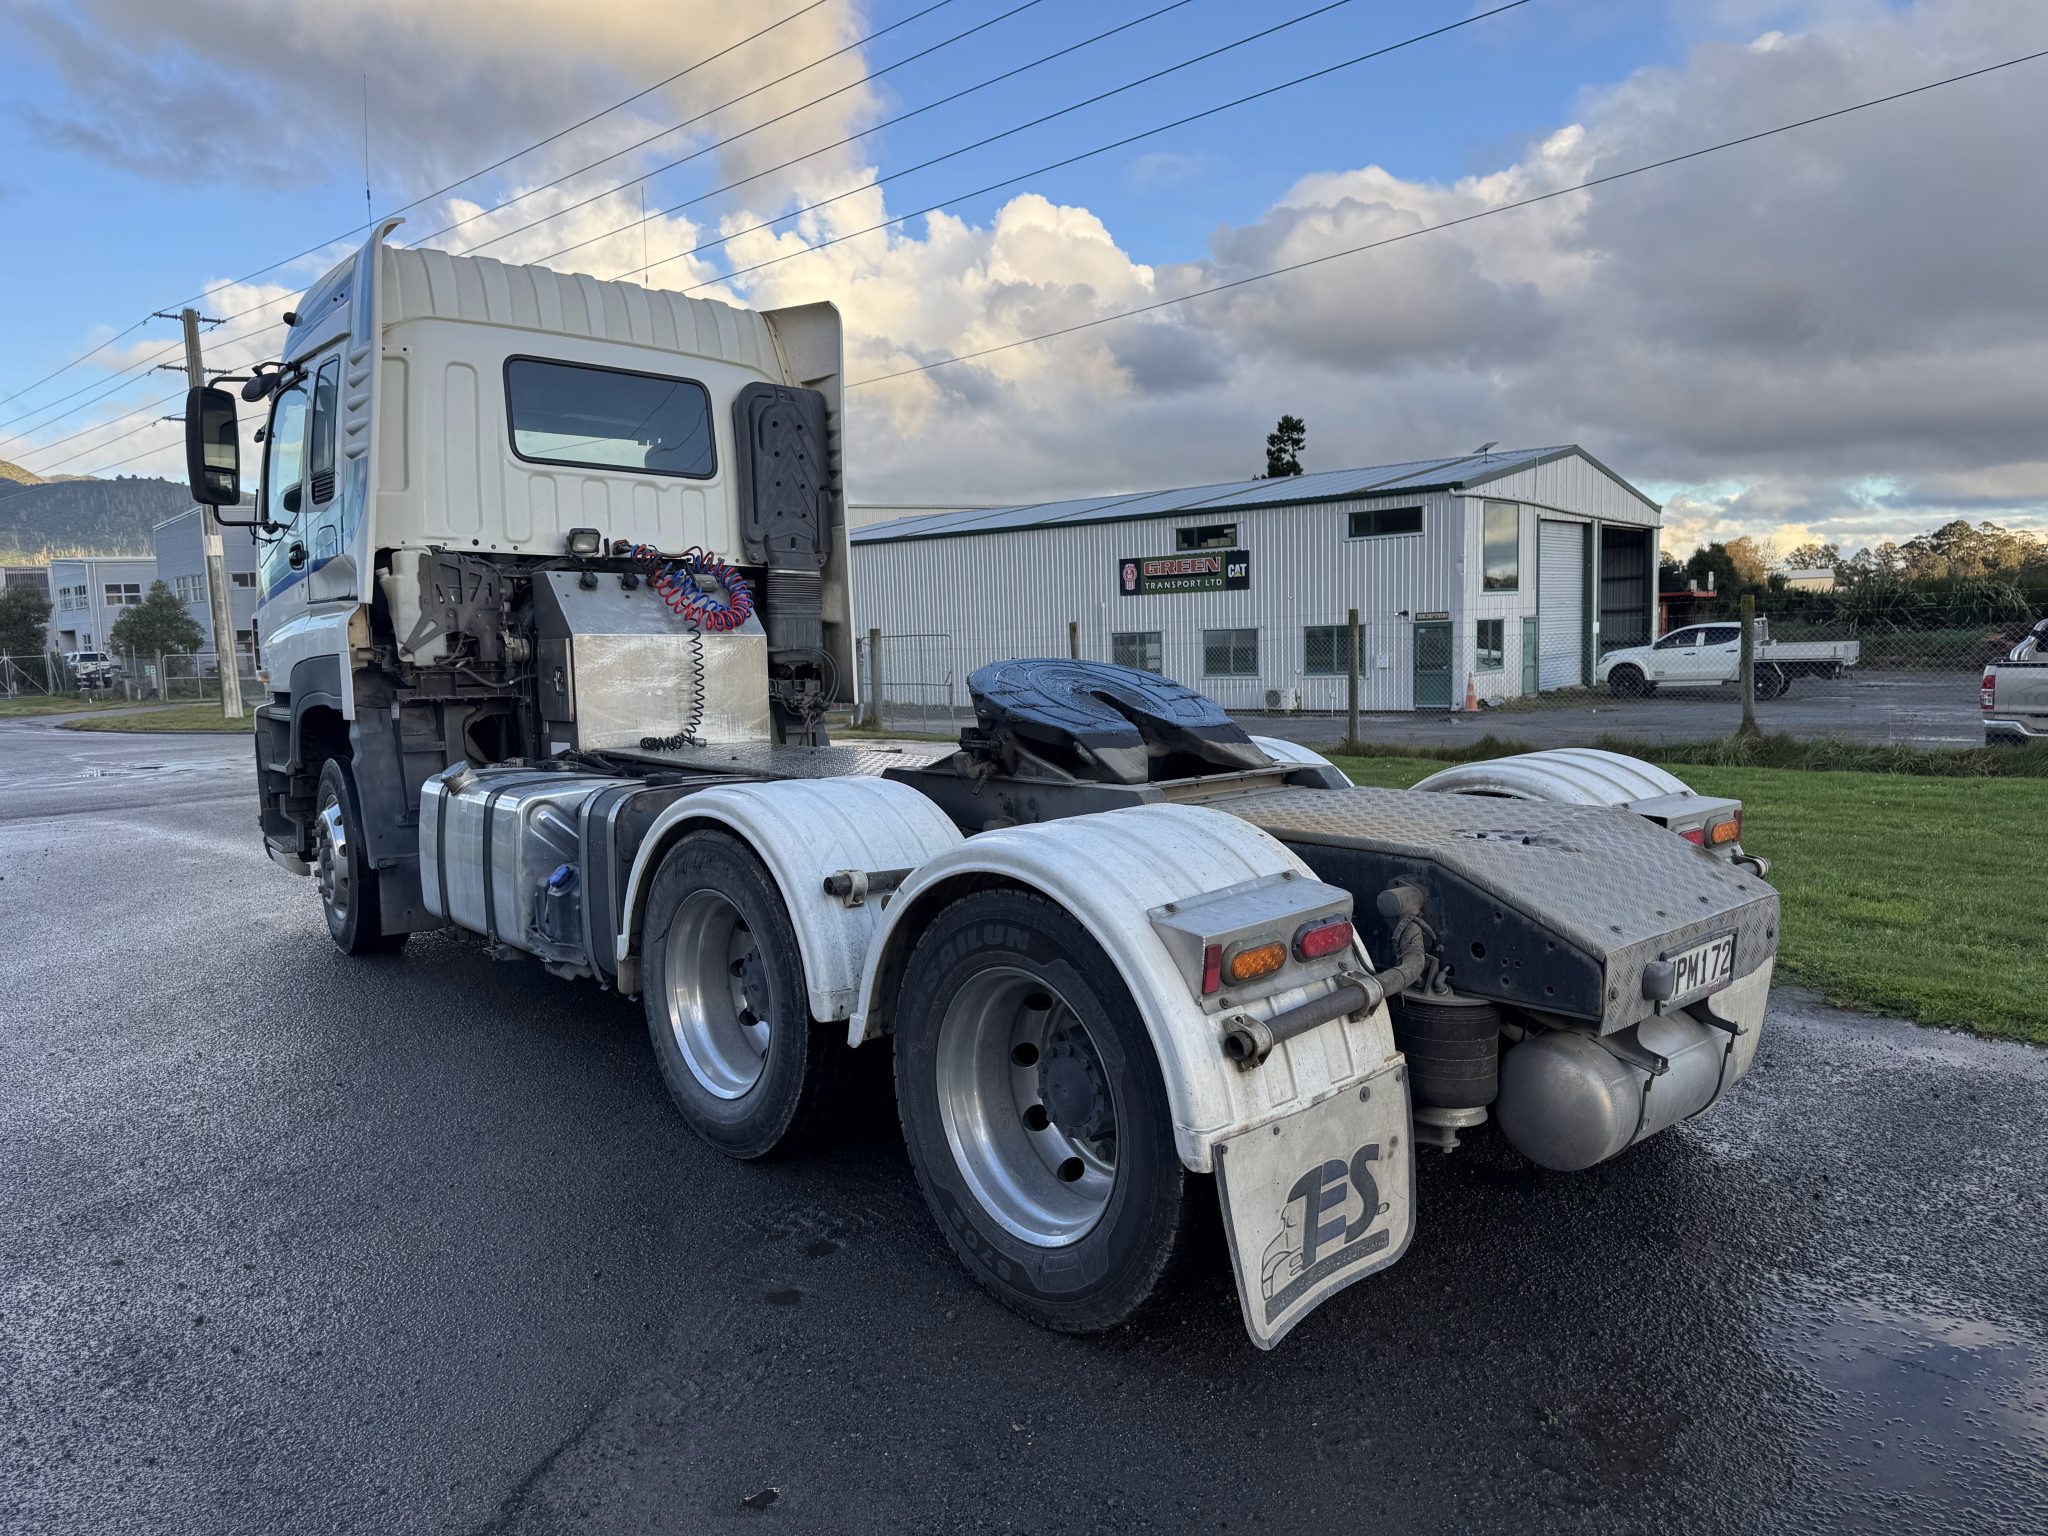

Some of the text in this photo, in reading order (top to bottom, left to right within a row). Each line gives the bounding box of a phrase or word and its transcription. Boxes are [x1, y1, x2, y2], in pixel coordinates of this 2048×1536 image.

[1143, 556, 1222, 577] GREEN
[1227, 563, 1247, 578] CAT
[1145, 578, 1223, 590] TRANSPORT LTD
[922, 924, 1030, 993] SAILUN
